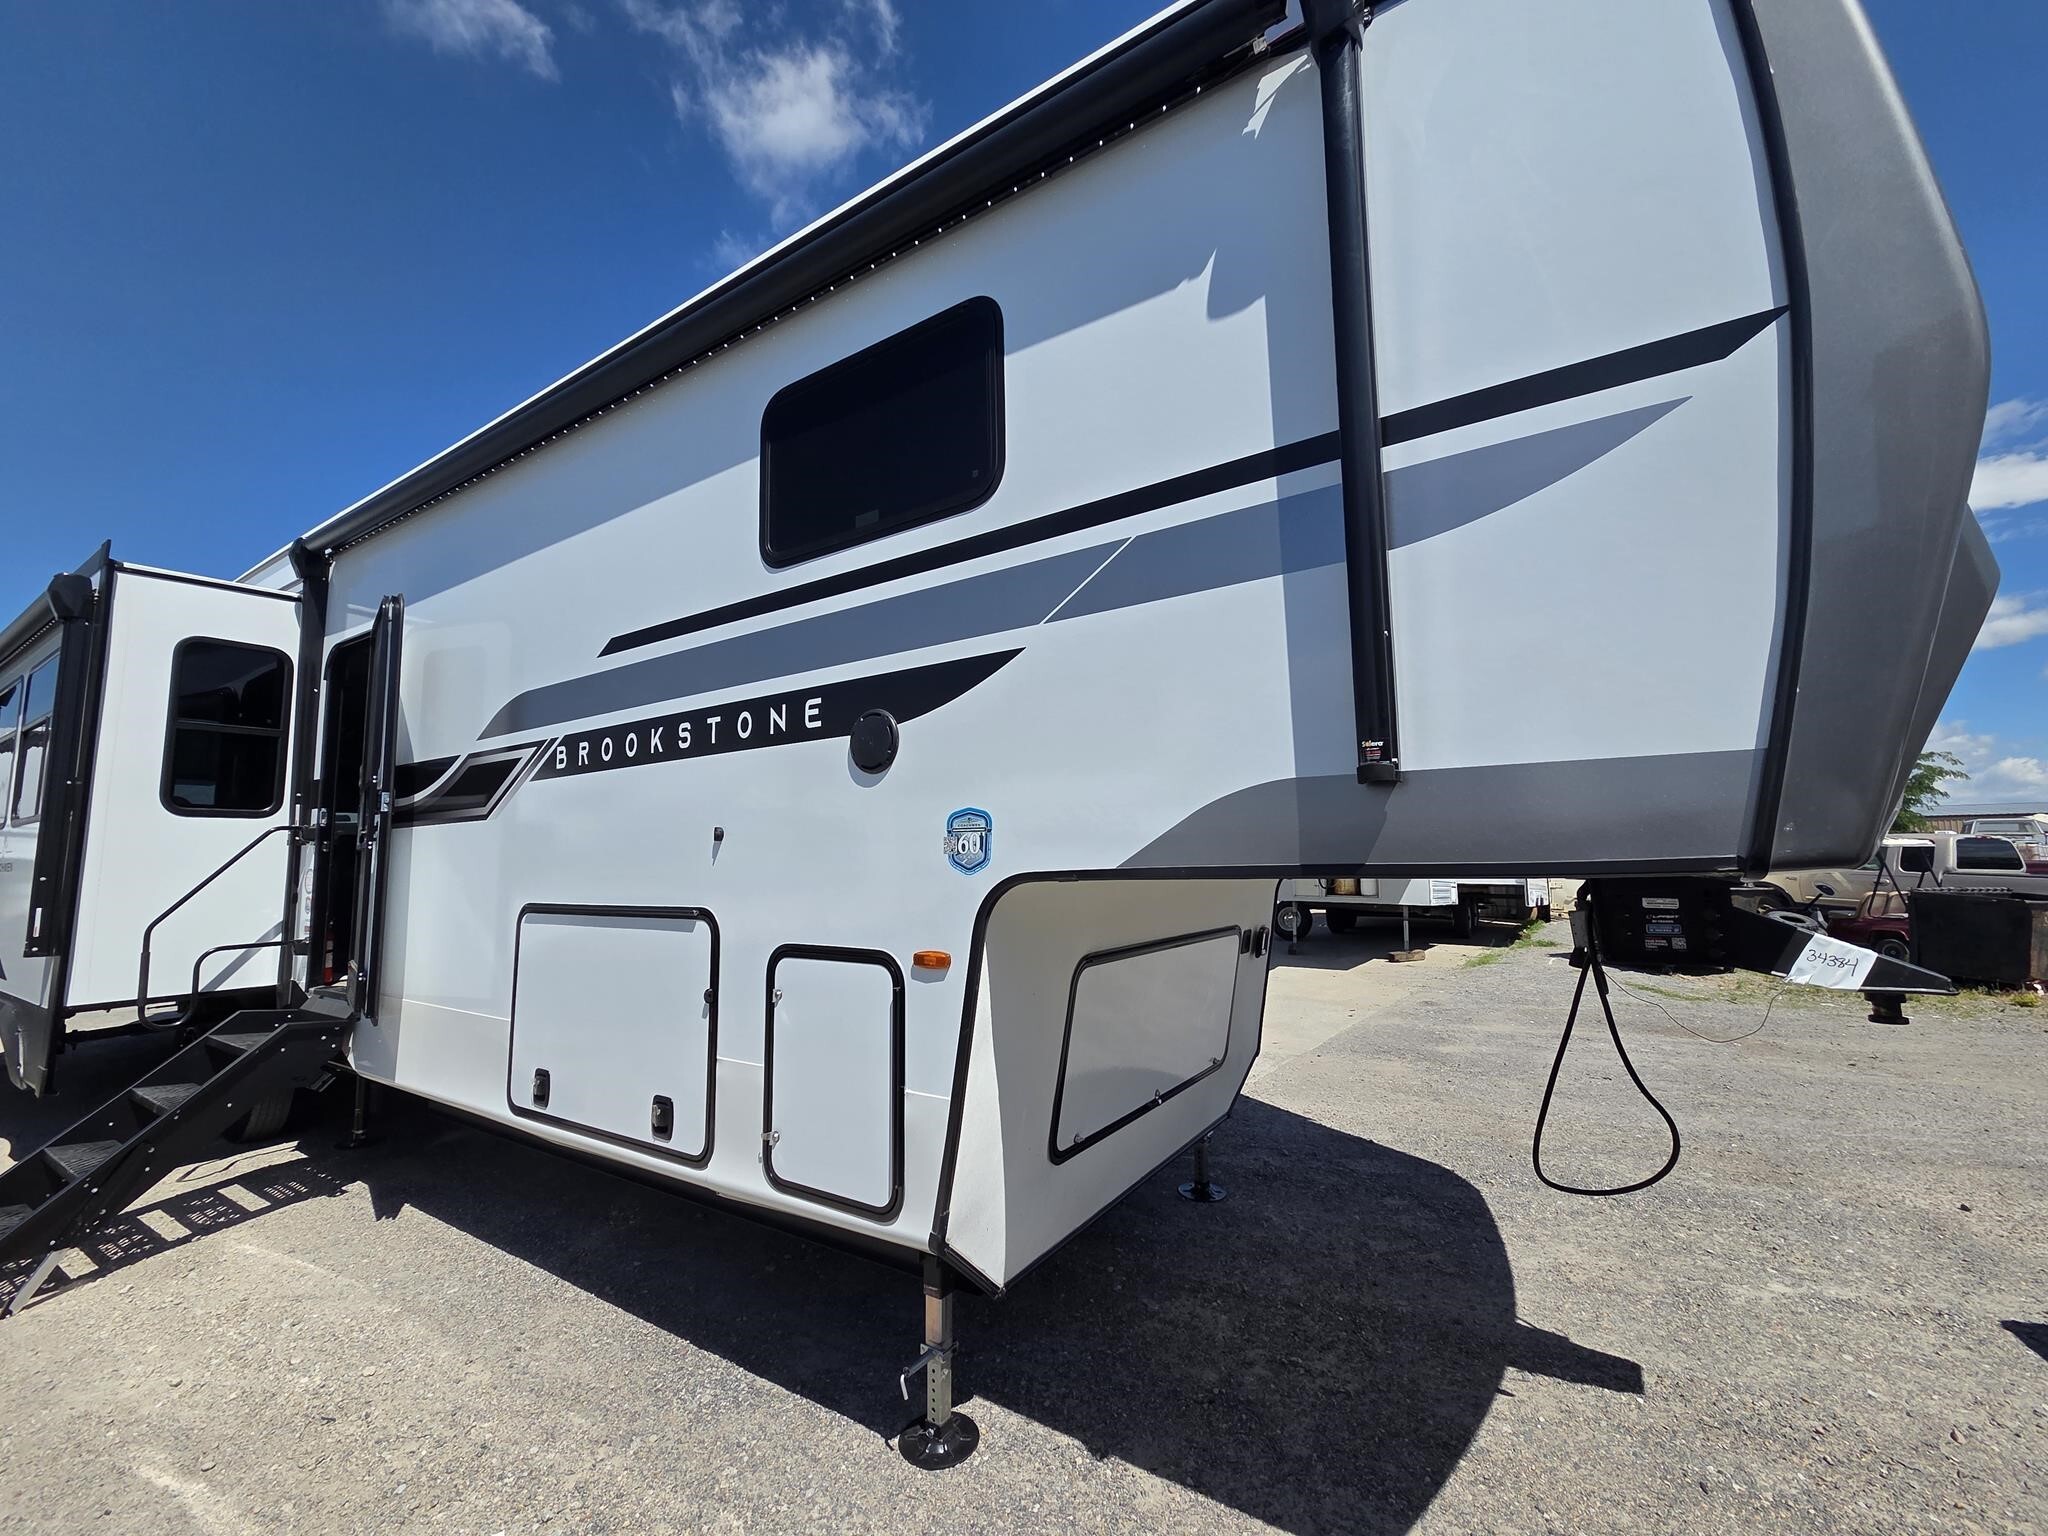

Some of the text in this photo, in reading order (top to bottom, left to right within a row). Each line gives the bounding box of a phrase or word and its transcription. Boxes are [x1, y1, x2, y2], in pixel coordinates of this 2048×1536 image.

[555, 697, 823, 769] BROOKSTONE
[957, 833, 981, 854] 60
[1806, 949, 1859, 977] 34384
